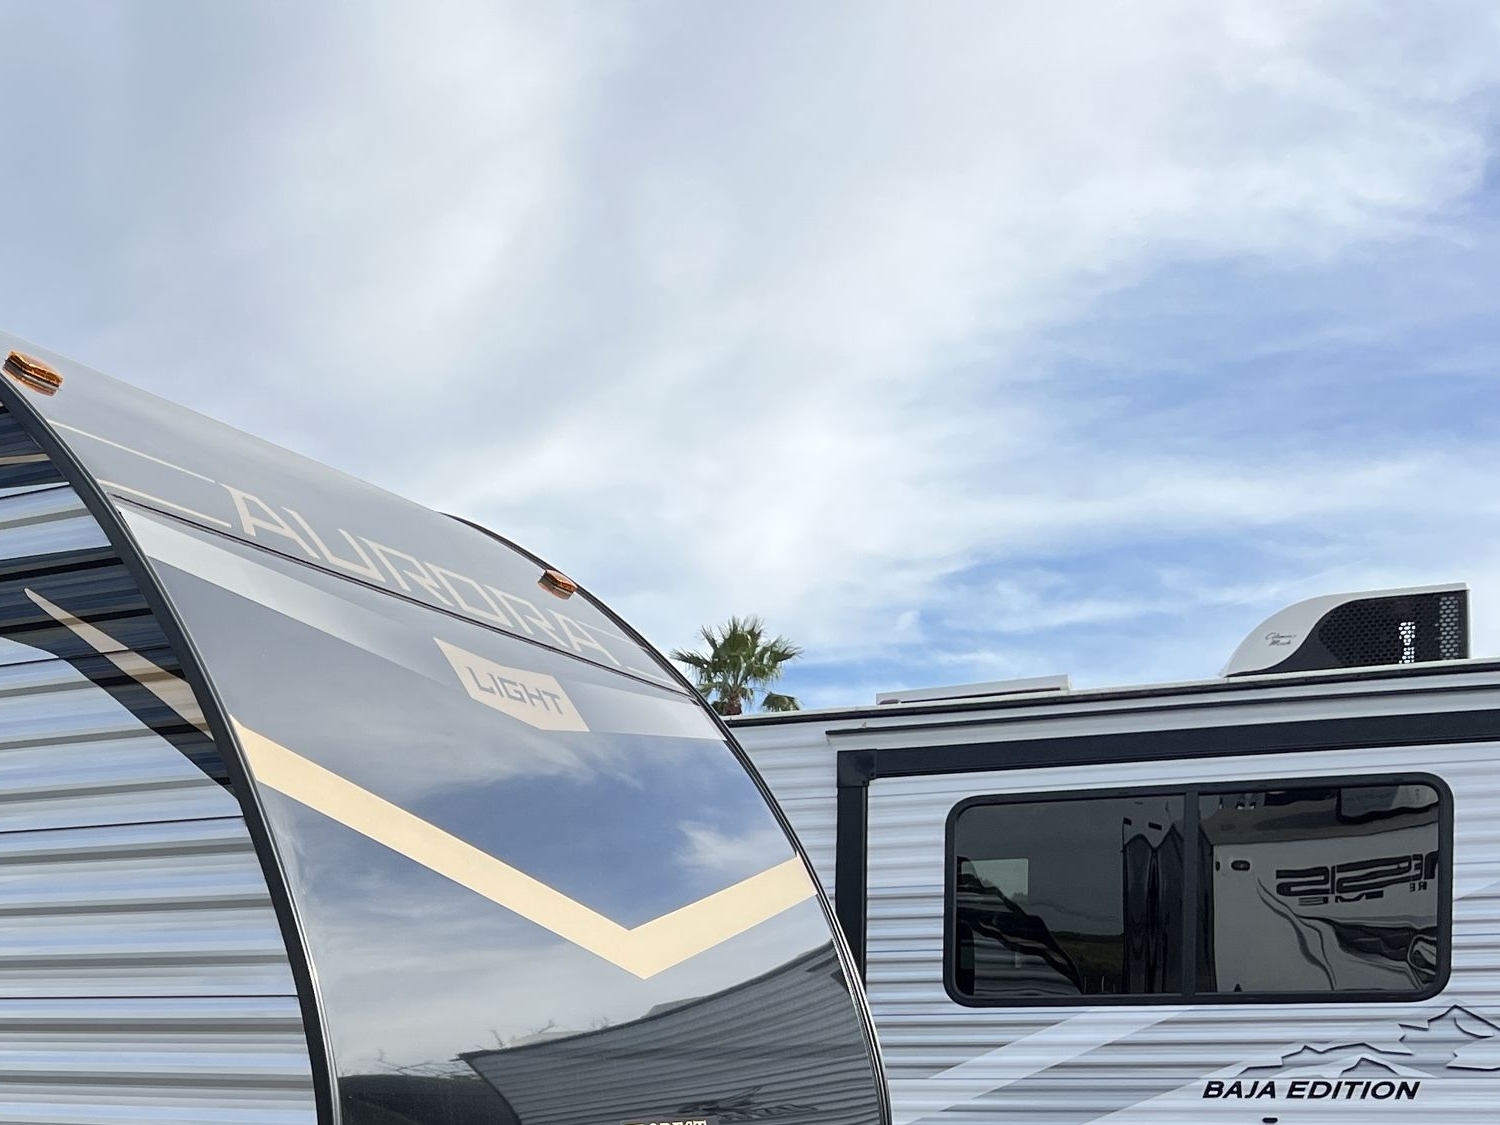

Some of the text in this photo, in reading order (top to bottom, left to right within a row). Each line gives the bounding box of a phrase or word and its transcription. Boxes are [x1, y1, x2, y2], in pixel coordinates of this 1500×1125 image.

[221, 483, 622, 667] AURORA
[466, 665, 566, 715] LIGHT
[1202, 1080, 1421, 1100] BAJA EDITION
